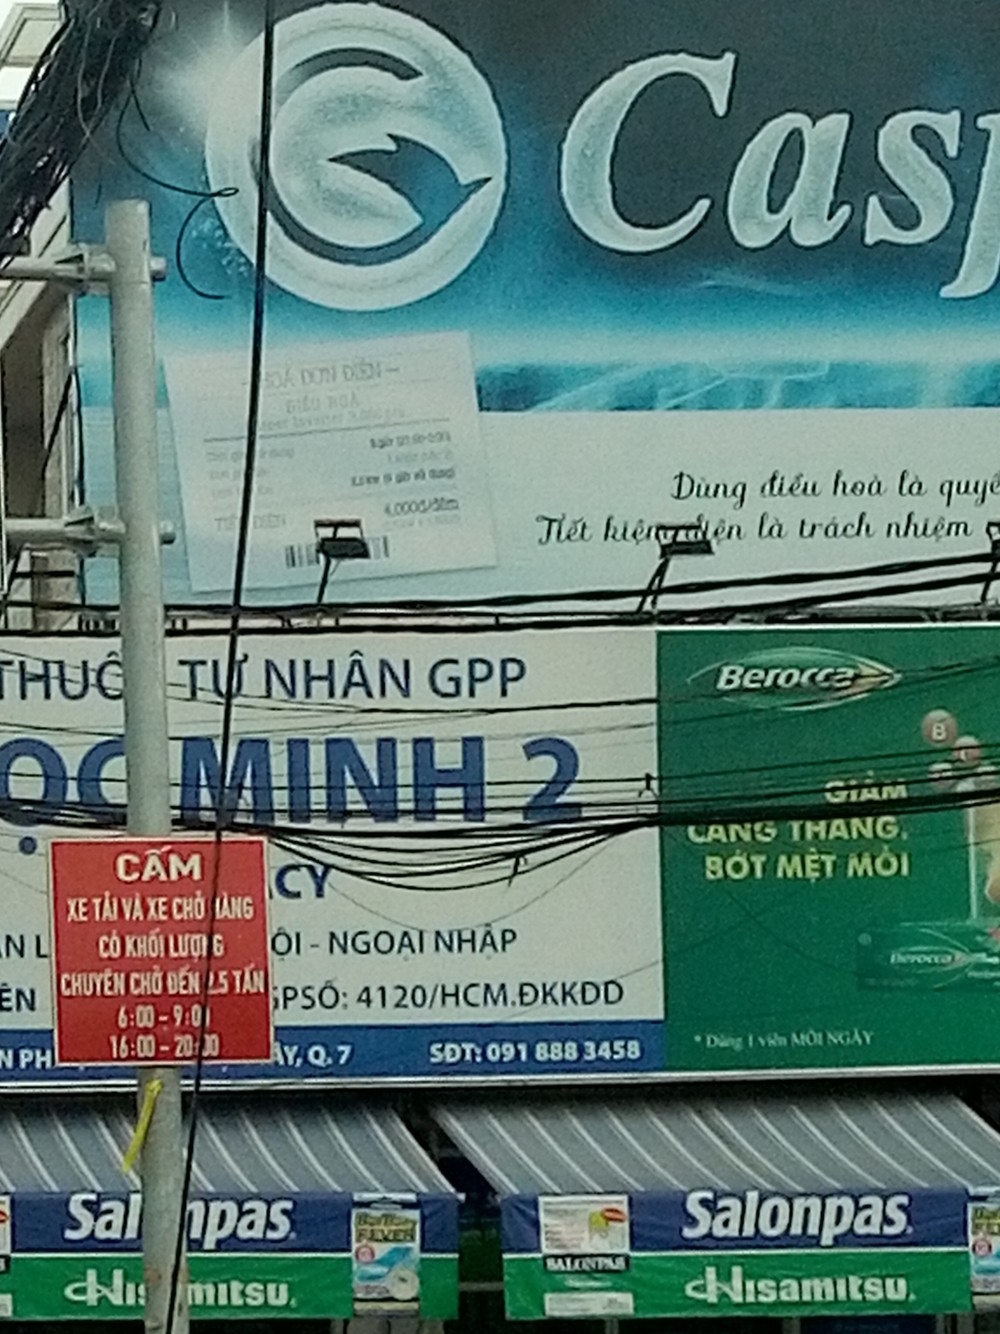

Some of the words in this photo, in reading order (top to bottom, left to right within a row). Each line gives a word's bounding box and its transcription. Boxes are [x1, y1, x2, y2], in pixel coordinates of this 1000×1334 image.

[898, 469, 928, 498] là
[758, 511, 788, 540] là
[799, 512, 874, 540] trách
[885, 511, 973, 543] nhiệm
[177, 652, 249, 700] TƯ
[264, 648, 411, 700] NHÂN
[428, 656, 527, 700] GPP
[716, 664, 856, 691] Berocca
[179, 735, 487, 827] MINH
[522, 735, 583, 823] 2
[115, 845, 203, 882] CẤM
[775, 847, 837, 886] MỆT
[66, 896, 89, 922] XE
[92, 890, 119, 922] TẢI
[122, 892, 144, 921] VÀ
[146, 896, 169, 922] XE
[124, 926, 165, 958] KHỐI
[270, 926, 301, 962] ỘI
[328, 929, 425, 962] NGOẠI
[434, 923, 517, 961] NHẬP
[60, 969, 126, 997] CHUYÊN
[166, 963, 200, 996] ĐẾN
[232, 962, 266, 994] TẤN
[117, 1004, 155, 1029] 6:00
[18, 1048, 53, 1070] PH
[108, 1034, 156, 1059] 16:00
[307, 1043, 333, 1067] Q.
[337, 1044, 353, 1064] 7
[429, 1043, 482, 1063] SĐT:
[486, 1042, 528, 1063] 091
[535, 1041, 578, 1062] 888
[583, 1039, 641, 1062] 3458
[64, 1192, 295, 1250] Salnpas
[681, 1189, 911, 1247] Salonpas
[63, 1268, 290, 1307] Himitsu
[684, 1265, 908, 1304] Hisamitsu
